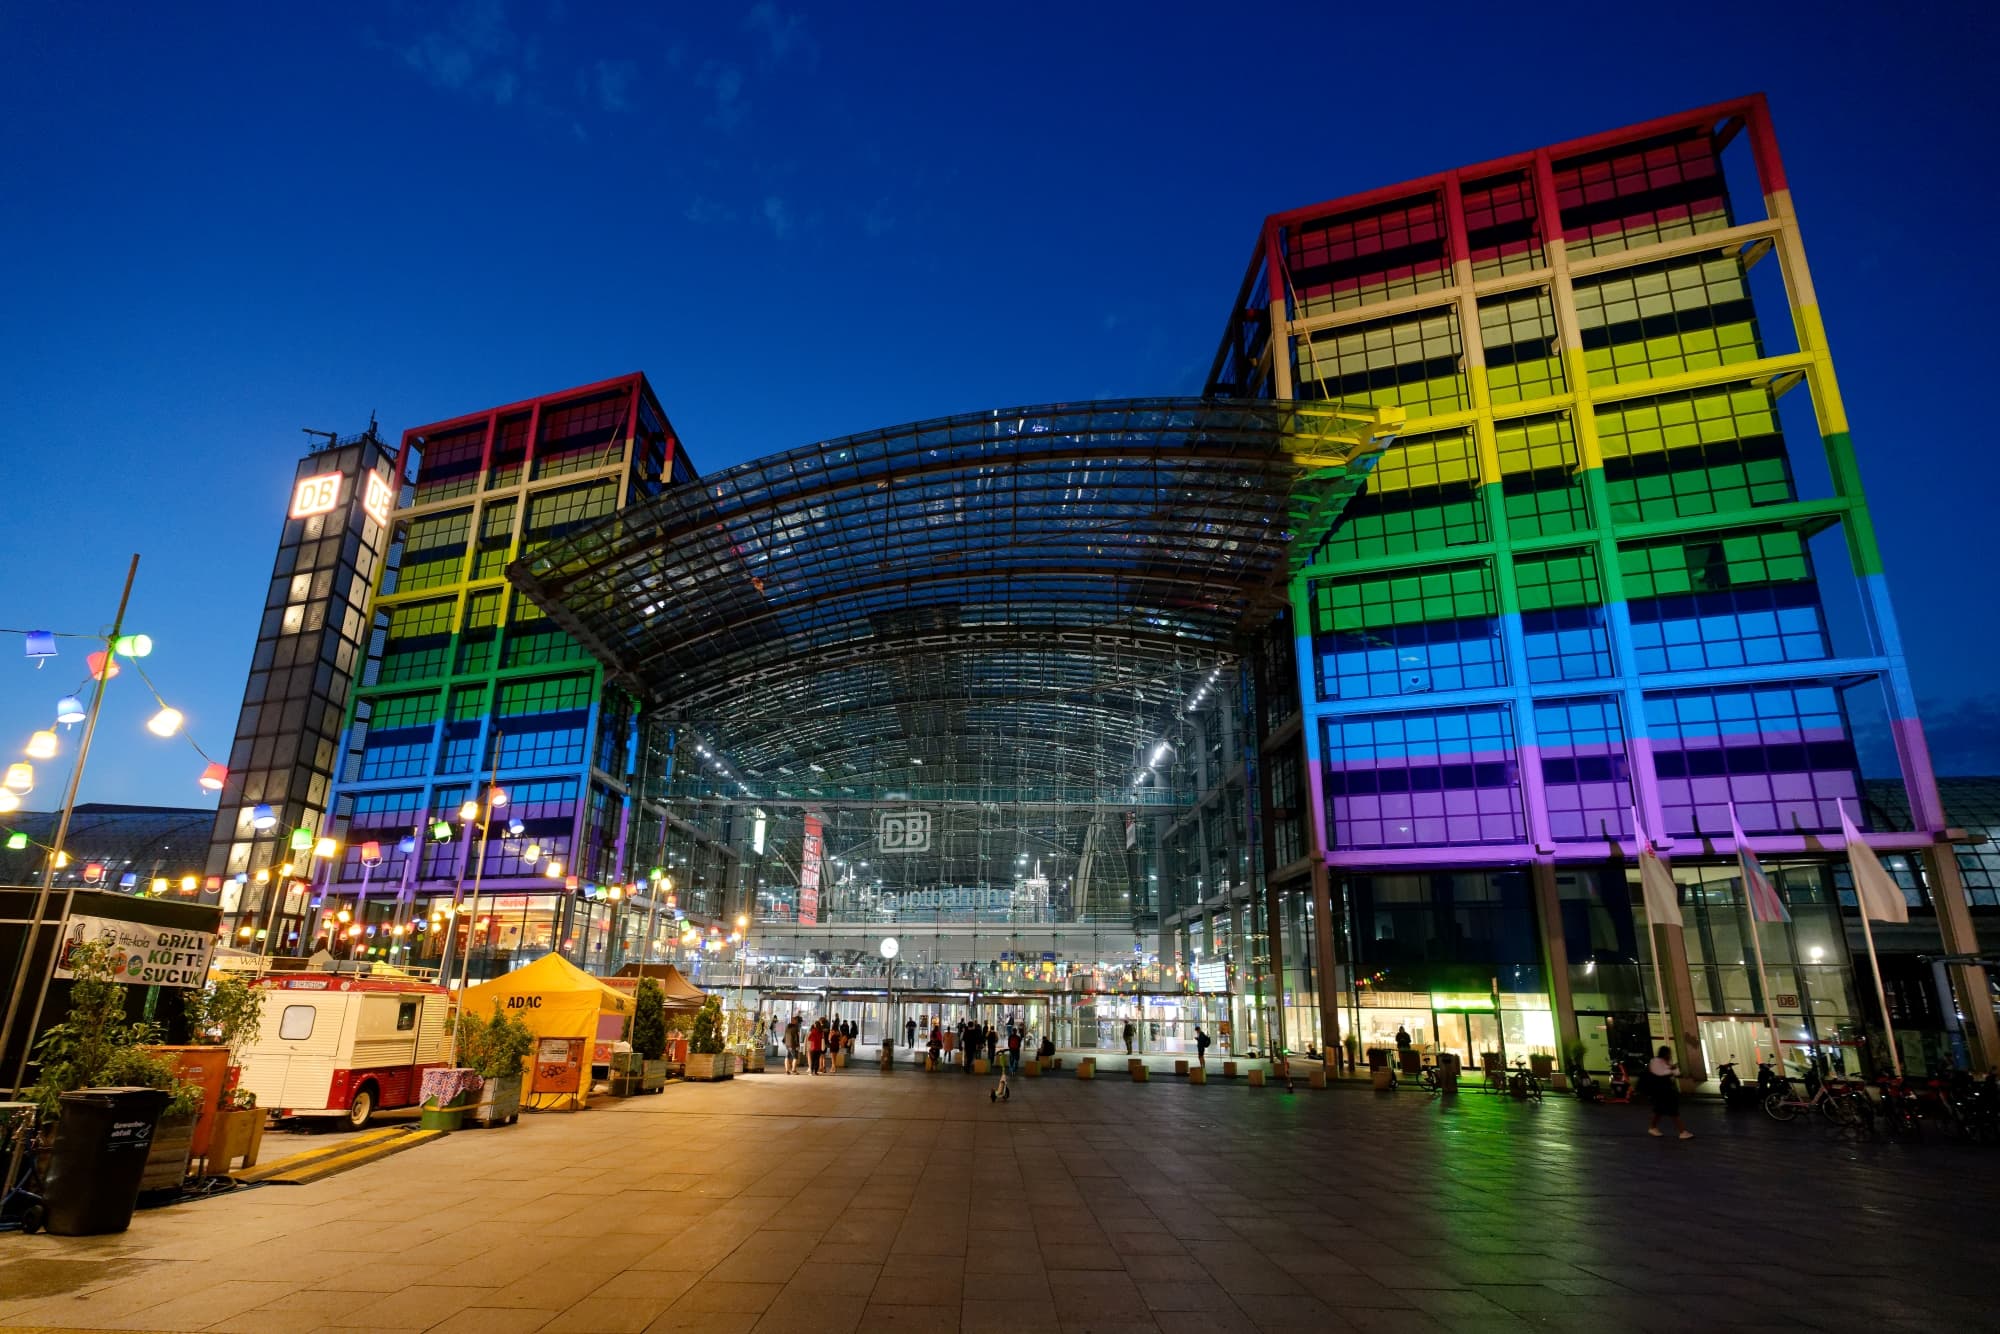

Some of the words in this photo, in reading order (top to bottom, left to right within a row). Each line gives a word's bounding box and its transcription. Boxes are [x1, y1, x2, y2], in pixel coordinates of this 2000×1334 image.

[300, 480, 334, 510] DB
[886, 819, 924, 846] DB
[147, 949, 203, 967] KÖFTE
[142, 967, 200, 985] SUCUK
[507, 996, 542, 1009] ADAC
